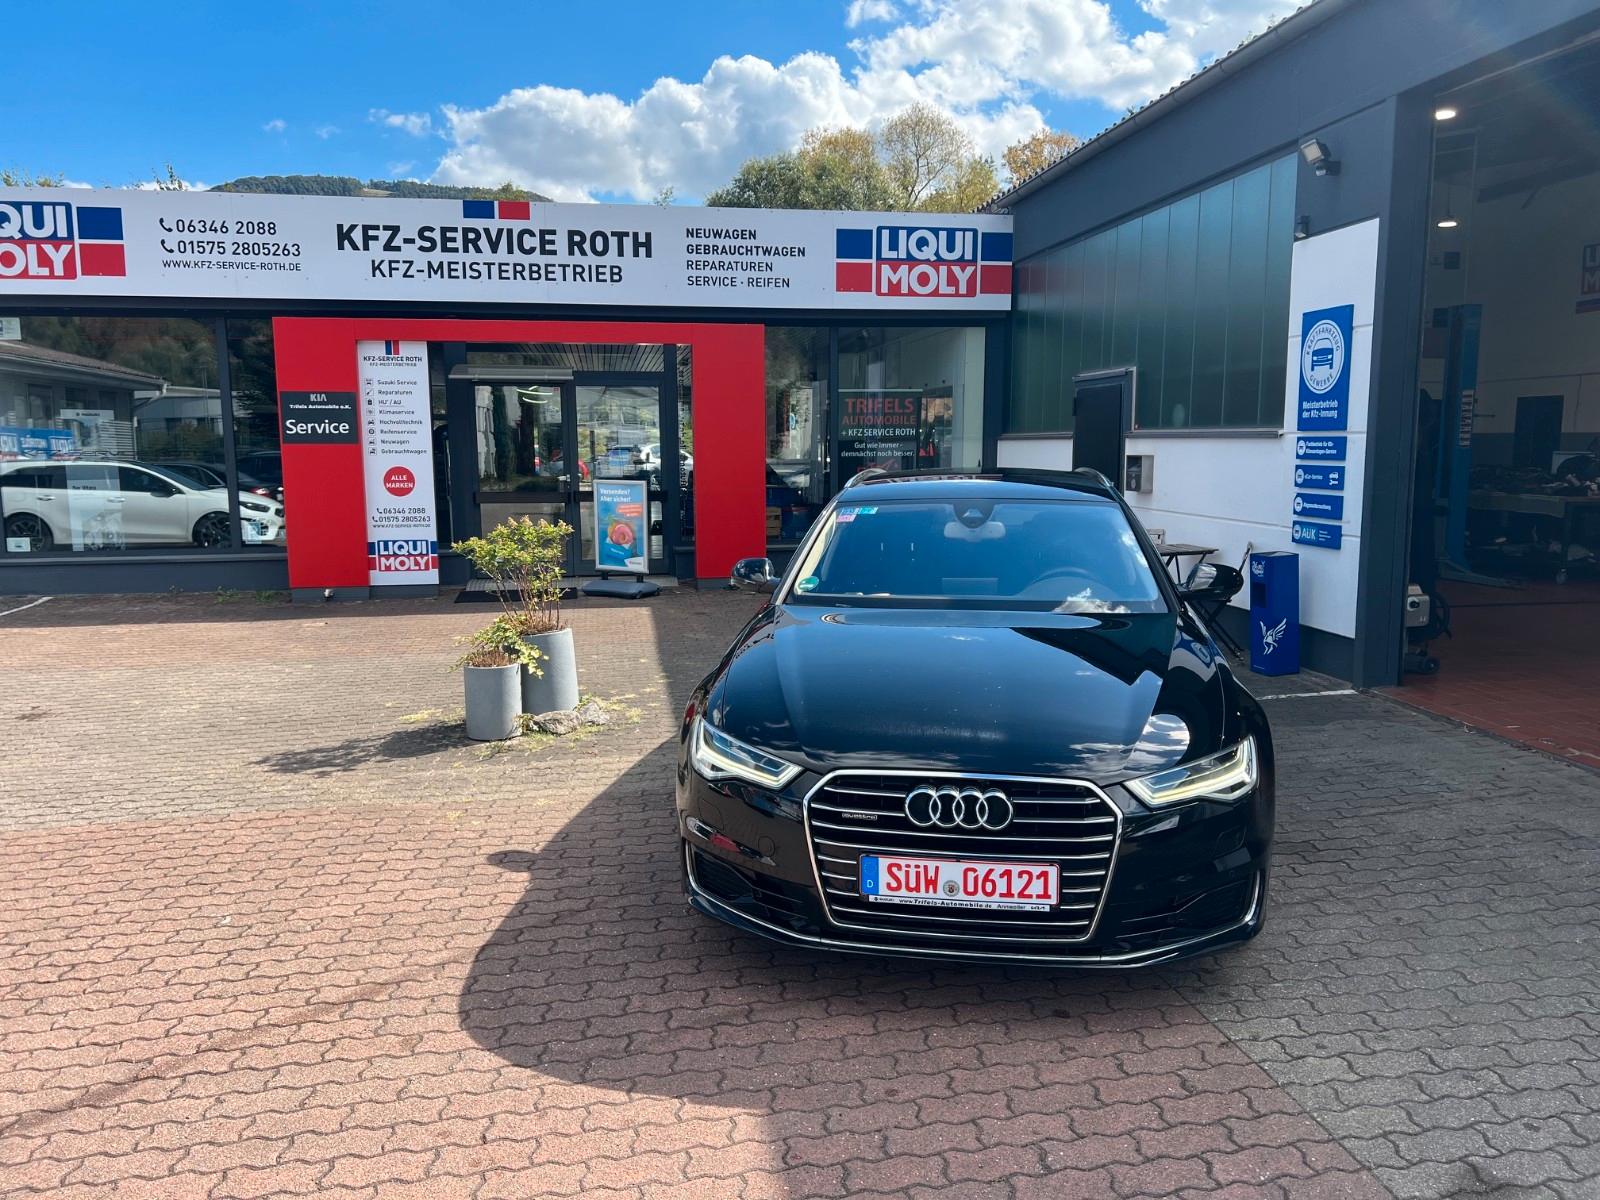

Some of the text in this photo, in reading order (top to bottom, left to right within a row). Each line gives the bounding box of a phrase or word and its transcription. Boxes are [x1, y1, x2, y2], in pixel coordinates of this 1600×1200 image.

[175, 219, 277, 235] 06346 2088
[685, 227, 757, 241] NEUWAGEN
[336, 223, 653, 259] KFZ-SERVICE ROTH
[880, 228, 974, 262] LIQUI
[177, 240, 301, 257] 01575 2805263
[686, 243, 806, 258] GEBRAUCHTWAGEN
[162, 260, 301, 272] WWW.KFZ-SERVICE-ROTH.DE
[371, 259, 624, 283] KFZ-MEISTERBETRIEB
[686, 259, 774, 273] REPARATUREN
[687, 275, 791, 289] SERVICE REIFEN
[880, 264, 976, 295] MOLY
[1306, 326, 1340, 356] KRAFTFAHRZEUG
[310, 393, 328, 402] KIA
[1303, 400, 1338, 409] Meisterbetrieb
[845, 399, 914, 413] TRIFELS
[285, 419, 350, 434] Service
[842, 415, 917, 425] AUTOMOBILE
[848, 428, 863, 437] KFZ
[863, 428, 895, 437] SERVICE
[895, 428, 916, 437] ROTH
[854, 441, 866, 449] Gut
[841, 449, 915, 457] demnächst noch besser.
[379, 540, 427, 555] LIQUI
[380, 556, 429, 571] MOLY
[867, 879, 874, 888] D
[886, 862, 940, 895] SÜW
[962, 867, 1052, 900] 06121
